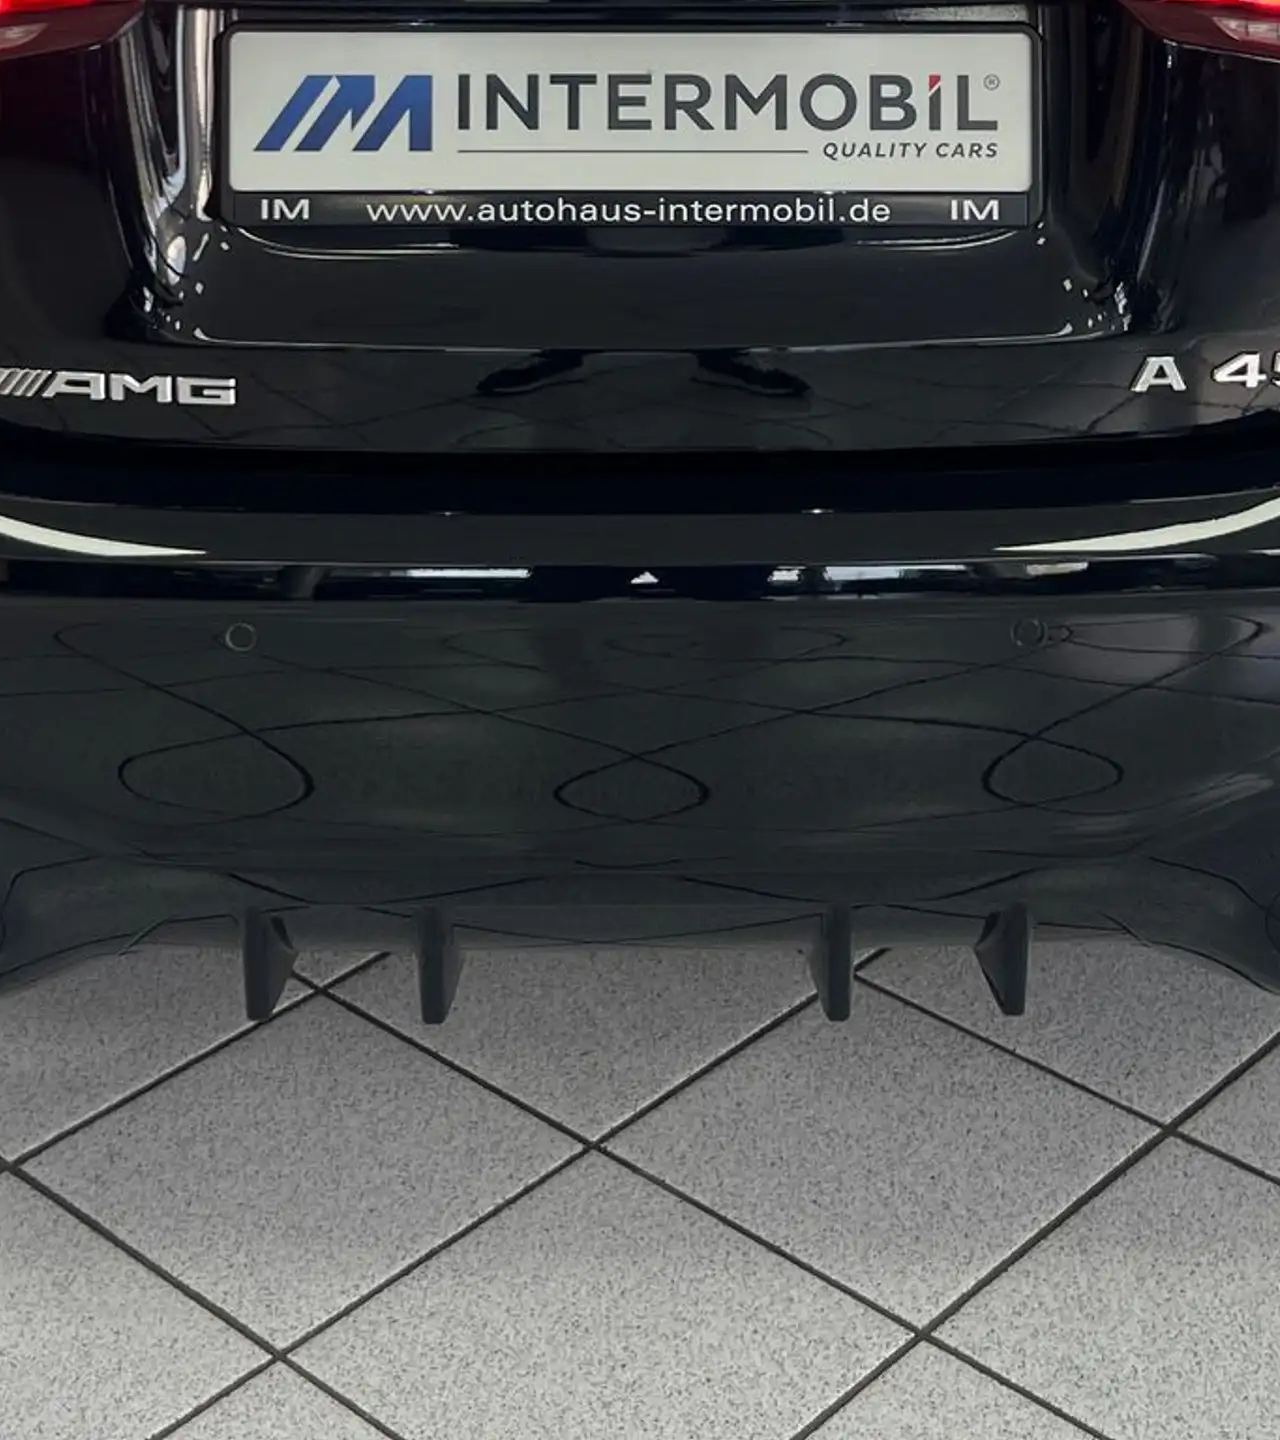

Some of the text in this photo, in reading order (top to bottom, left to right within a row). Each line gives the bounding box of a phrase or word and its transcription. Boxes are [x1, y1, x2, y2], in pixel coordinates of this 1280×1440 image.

[822, 141, 999, 161] QUALITY CARS
[260, 197, 310, 221] IM
[366, 196, 891, 223] www.autohaus-intermobil.de
[950, 198, 1000, 221] IM
[1130, 356, 1187, 393] A
